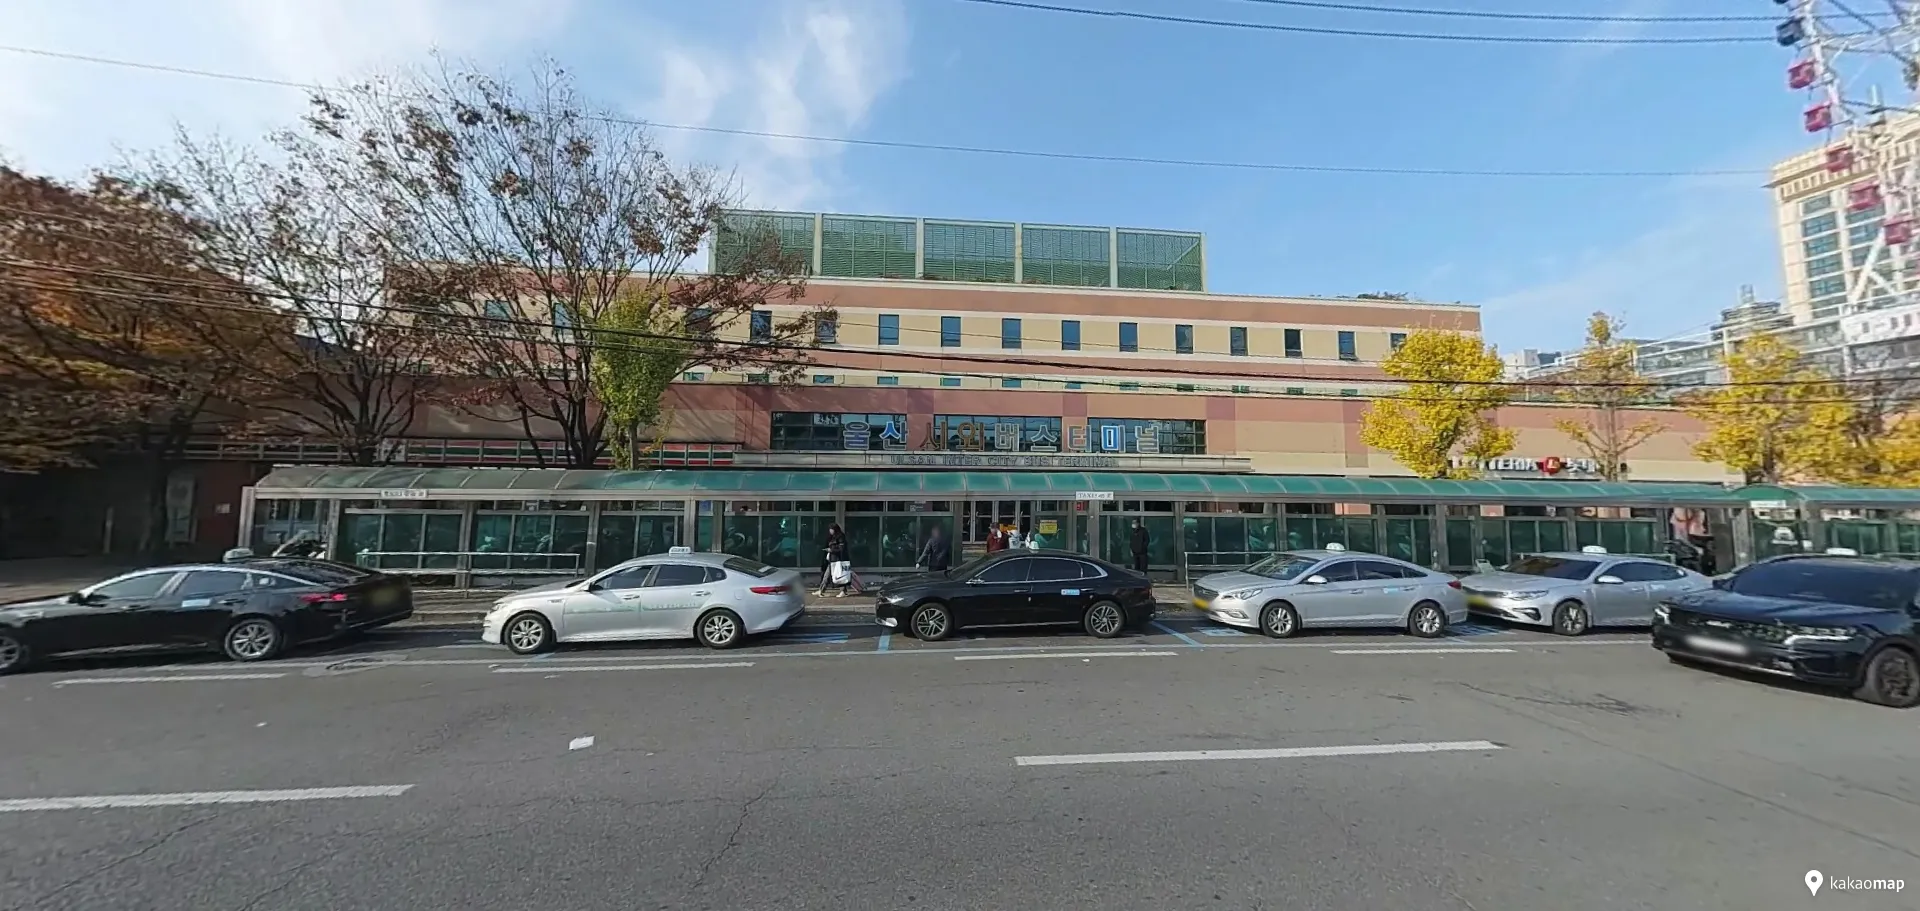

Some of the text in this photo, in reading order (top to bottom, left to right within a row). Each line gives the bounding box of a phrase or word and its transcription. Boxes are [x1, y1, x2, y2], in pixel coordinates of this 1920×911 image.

[843, 420, 1160, 454] 울산시외버스터미널
[890, 454, 1120, 468] ULSAN INTER CITY BUS TERMINAL
